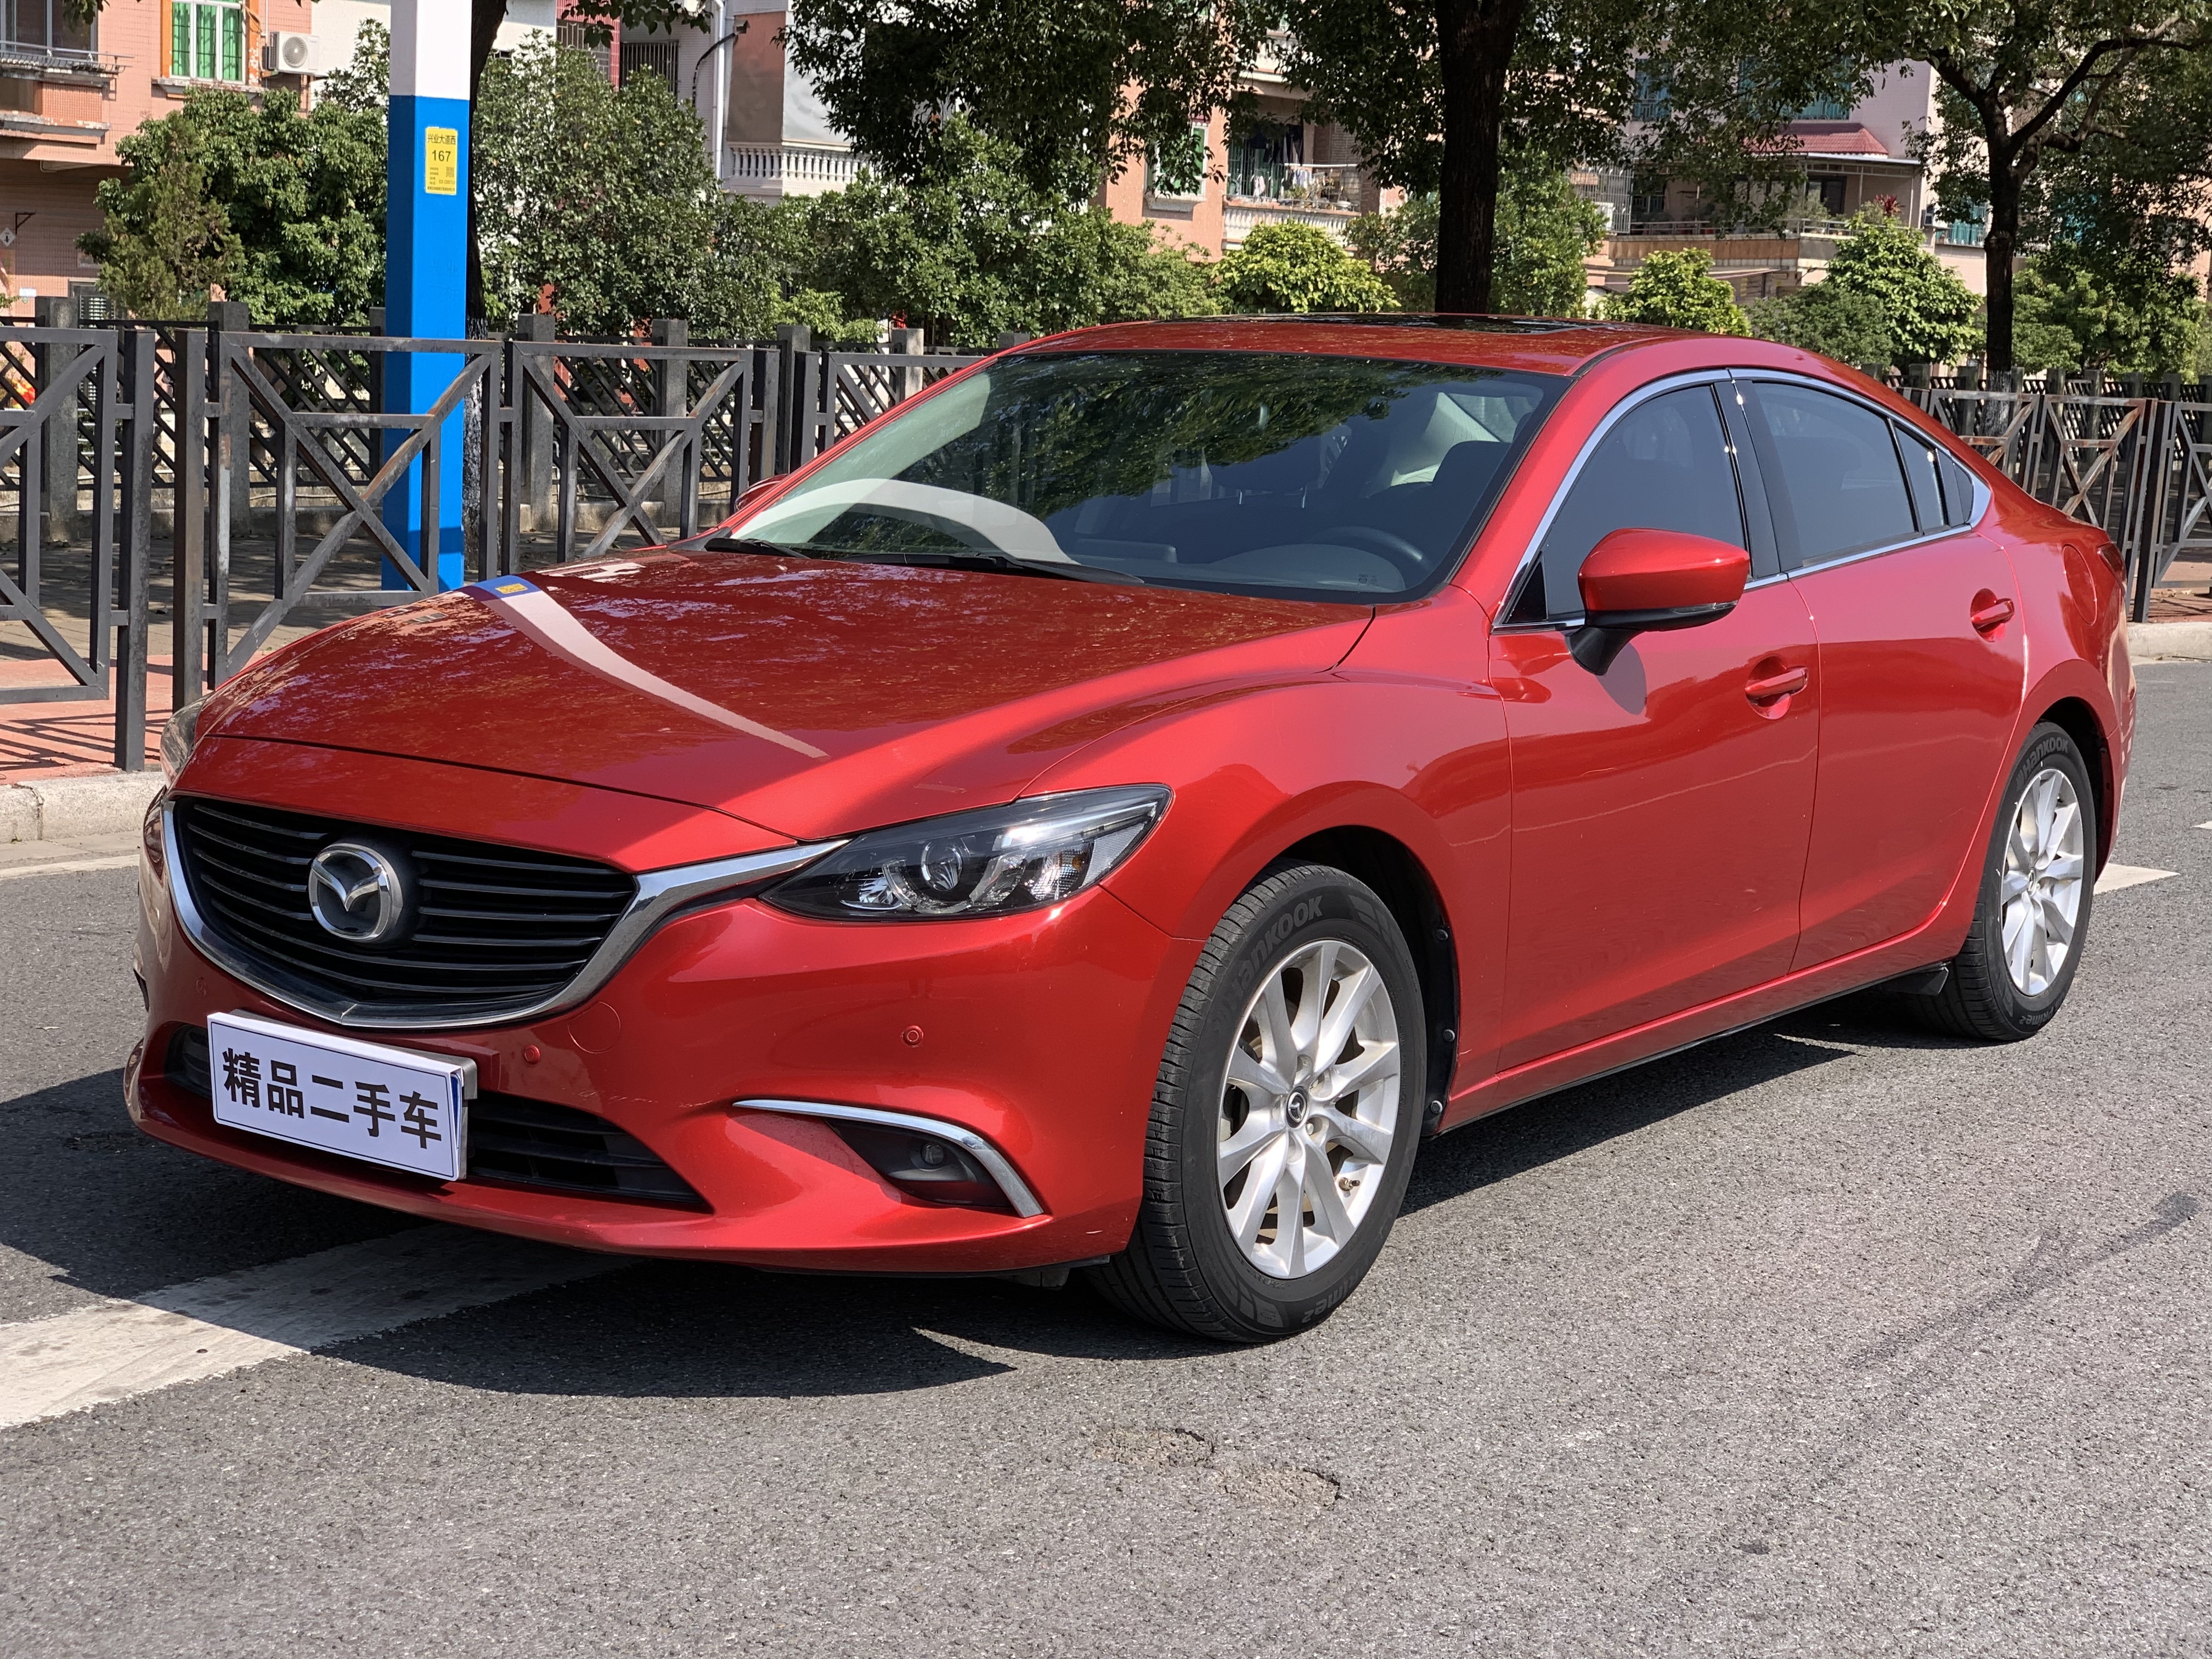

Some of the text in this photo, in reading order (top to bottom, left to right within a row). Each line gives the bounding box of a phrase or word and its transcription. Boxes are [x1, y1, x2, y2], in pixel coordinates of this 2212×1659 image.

[427, 133, 456, 145] 兴业大道西
[432, 150, 451, 162] 167
[223, 1047, 441, 1149] 精品二手车
